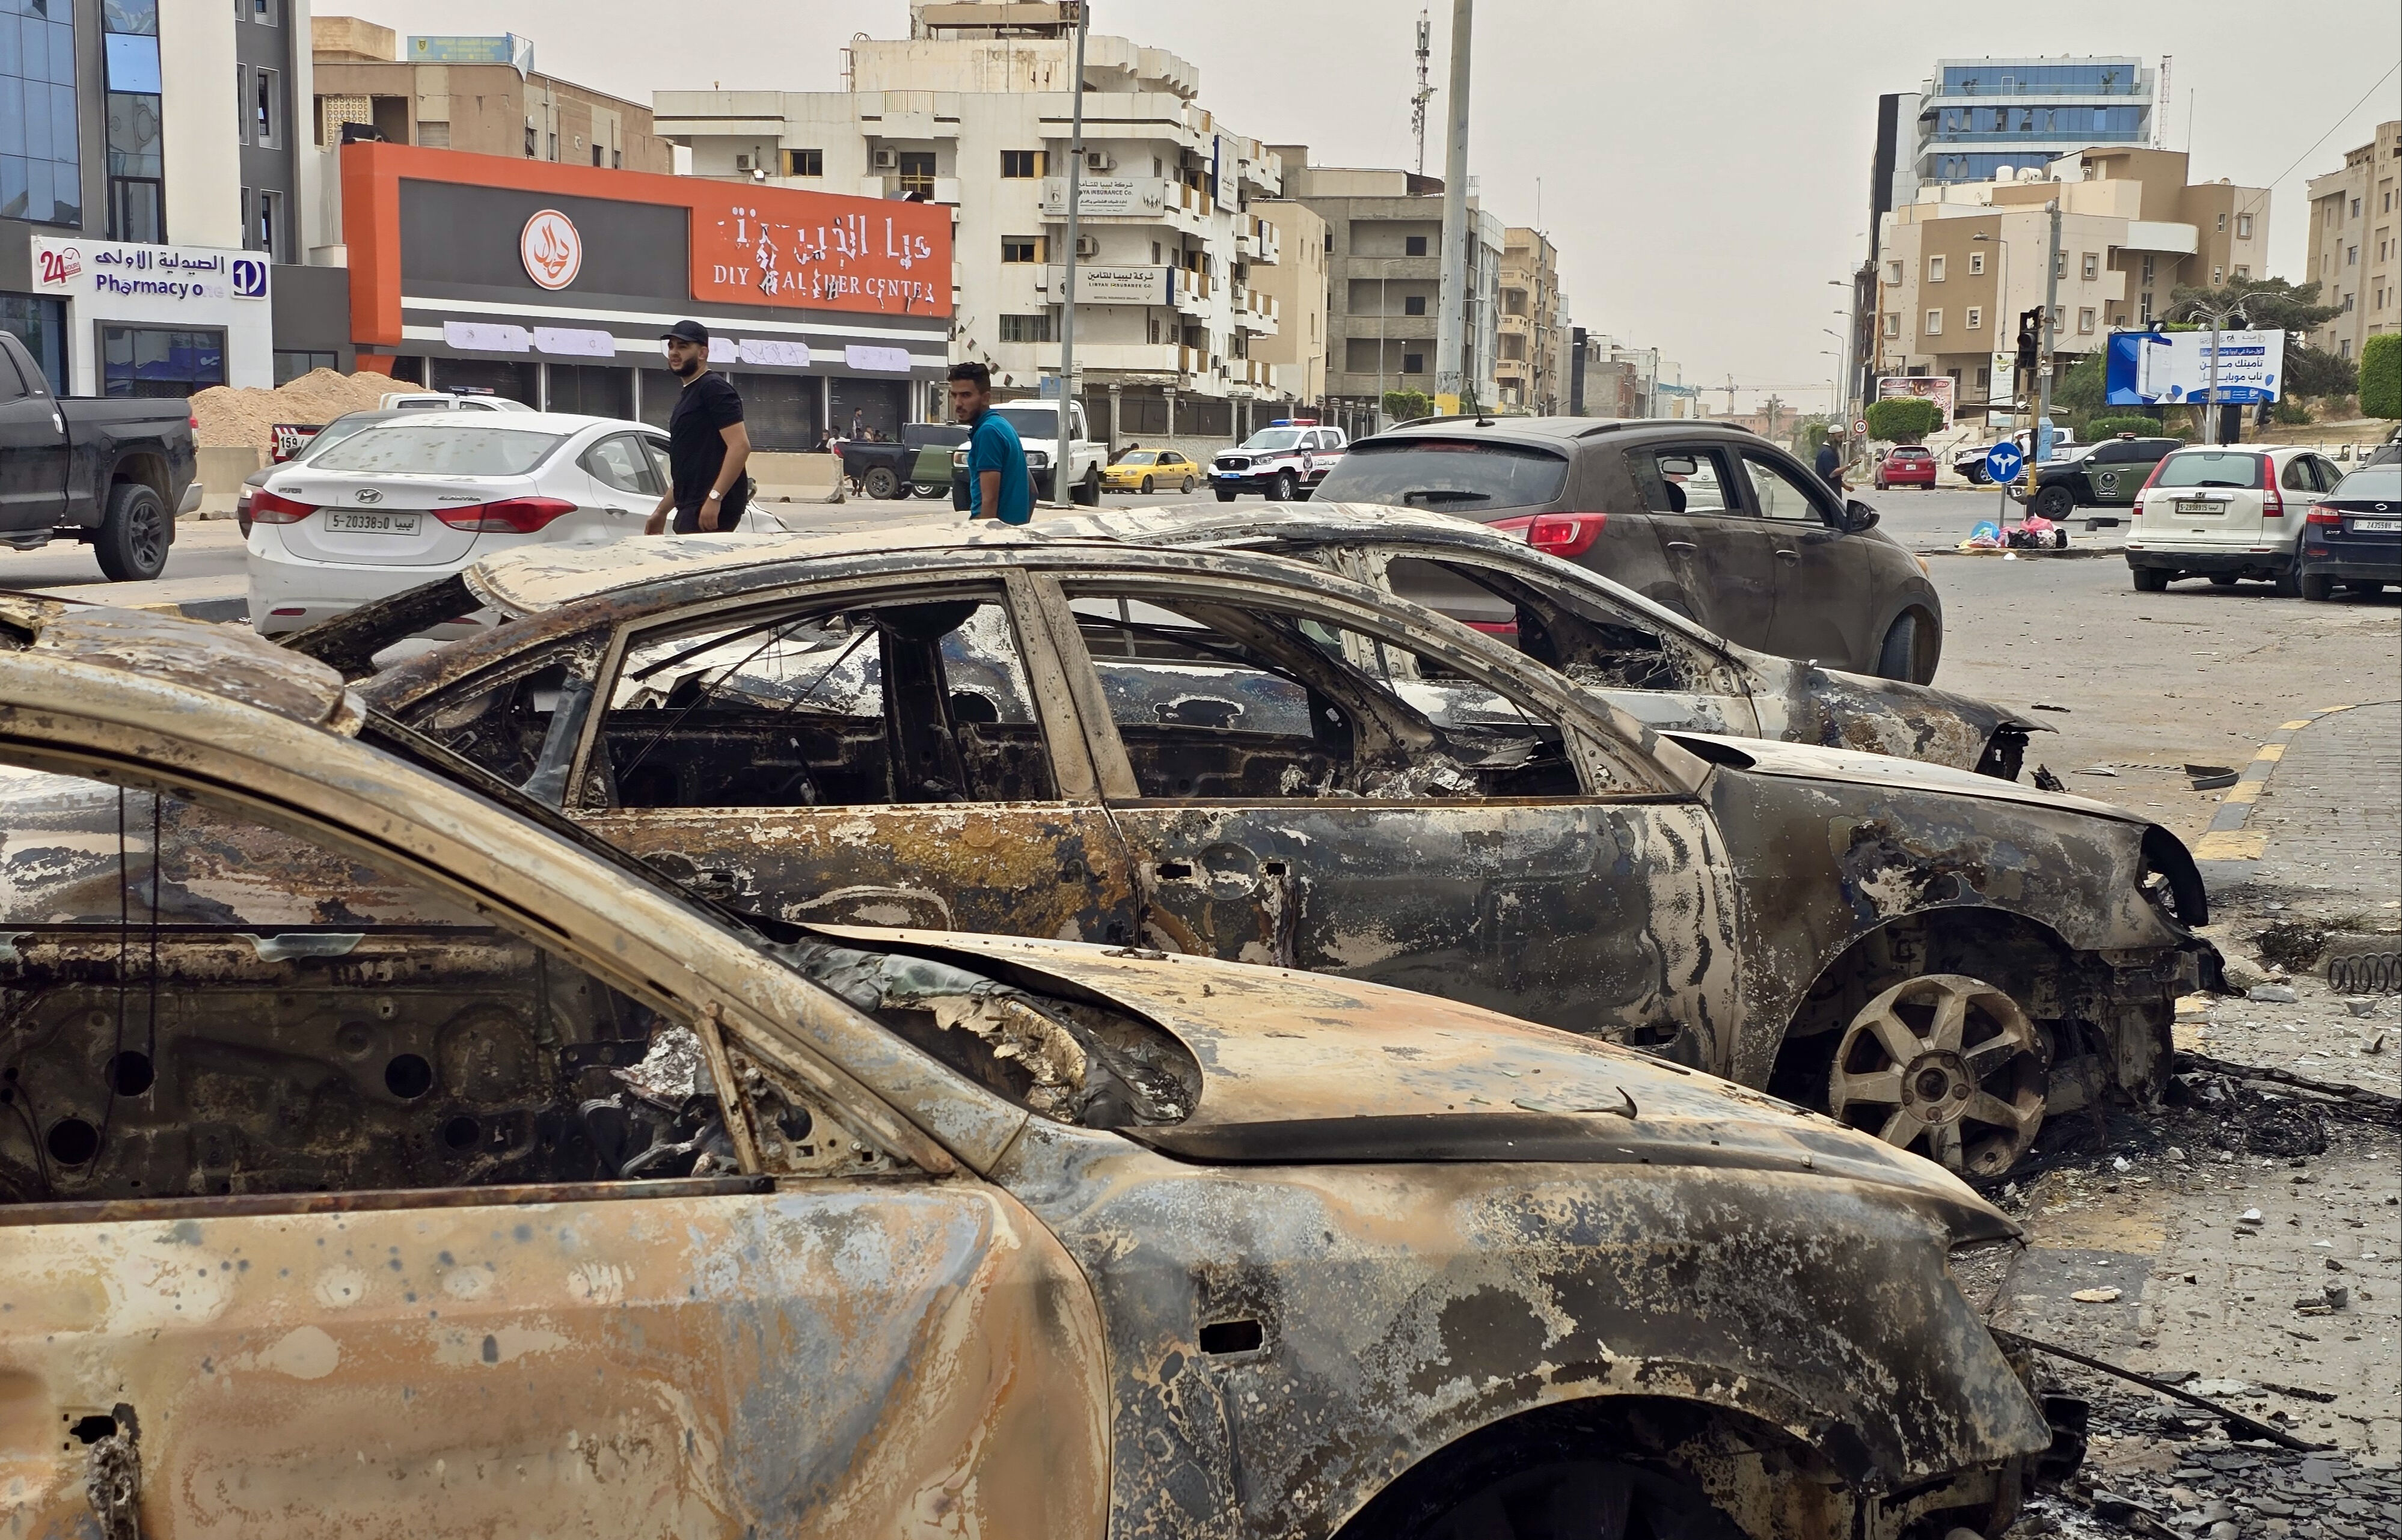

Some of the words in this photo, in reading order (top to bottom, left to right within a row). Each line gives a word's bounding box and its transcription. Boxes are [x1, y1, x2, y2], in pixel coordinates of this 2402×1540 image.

[40, 251, 66, 284] 24
[159, 252, 224, 276] الصيدلية
[1114, 272, 1132, 281] ليبيا
[1133, 272, 1154, 282] شركة
[96, 274, 188, 300] Pharmacy
[2235, 356, 2264, 370] تأمينك
